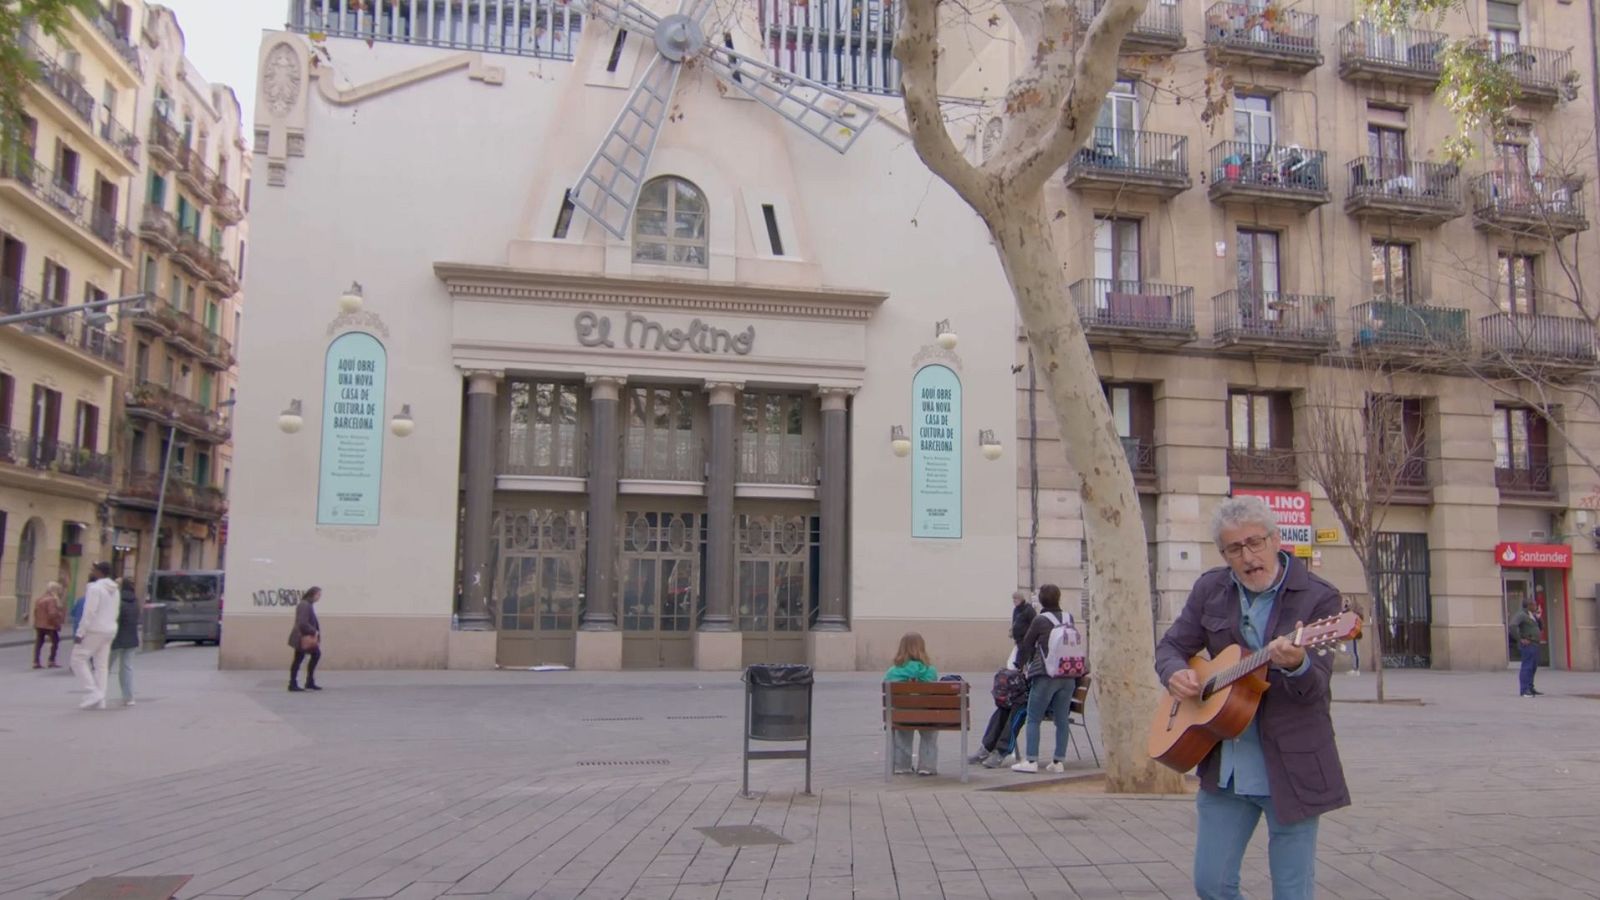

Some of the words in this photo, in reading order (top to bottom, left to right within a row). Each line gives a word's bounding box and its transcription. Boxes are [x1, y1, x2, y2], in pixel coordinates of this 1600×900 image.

[357, 359, 375, 372] OBRE
[338, 373, 353, 385] UNA
[355, 374, 373, 386] NOVA
[341, 388, 358, 400] CASA
[360, 388, 369, 401] DE
[936, 388, 952, 400] OBRE
[333, 401, 365, 415] CULTURA
[366, 403, 376, 416] DE
[922, 400, 934, 412] UNA
[935, 401, 951, 413] NOVA
[333, 416, 374, 430] BARCELONA
[925, 414, 940, 426] CASA
[941, 414, 948, 426] DE
[919, 426, 945, 439] CULTURA
[946, 427, 954, 439] DE
[920, 439, 953, 452] BARCELONA
[1256, 495, 1305, 509] LINO
[1279, 527, 1309, 542] HANGE
[1519, 550, 1568, 563] Santander
